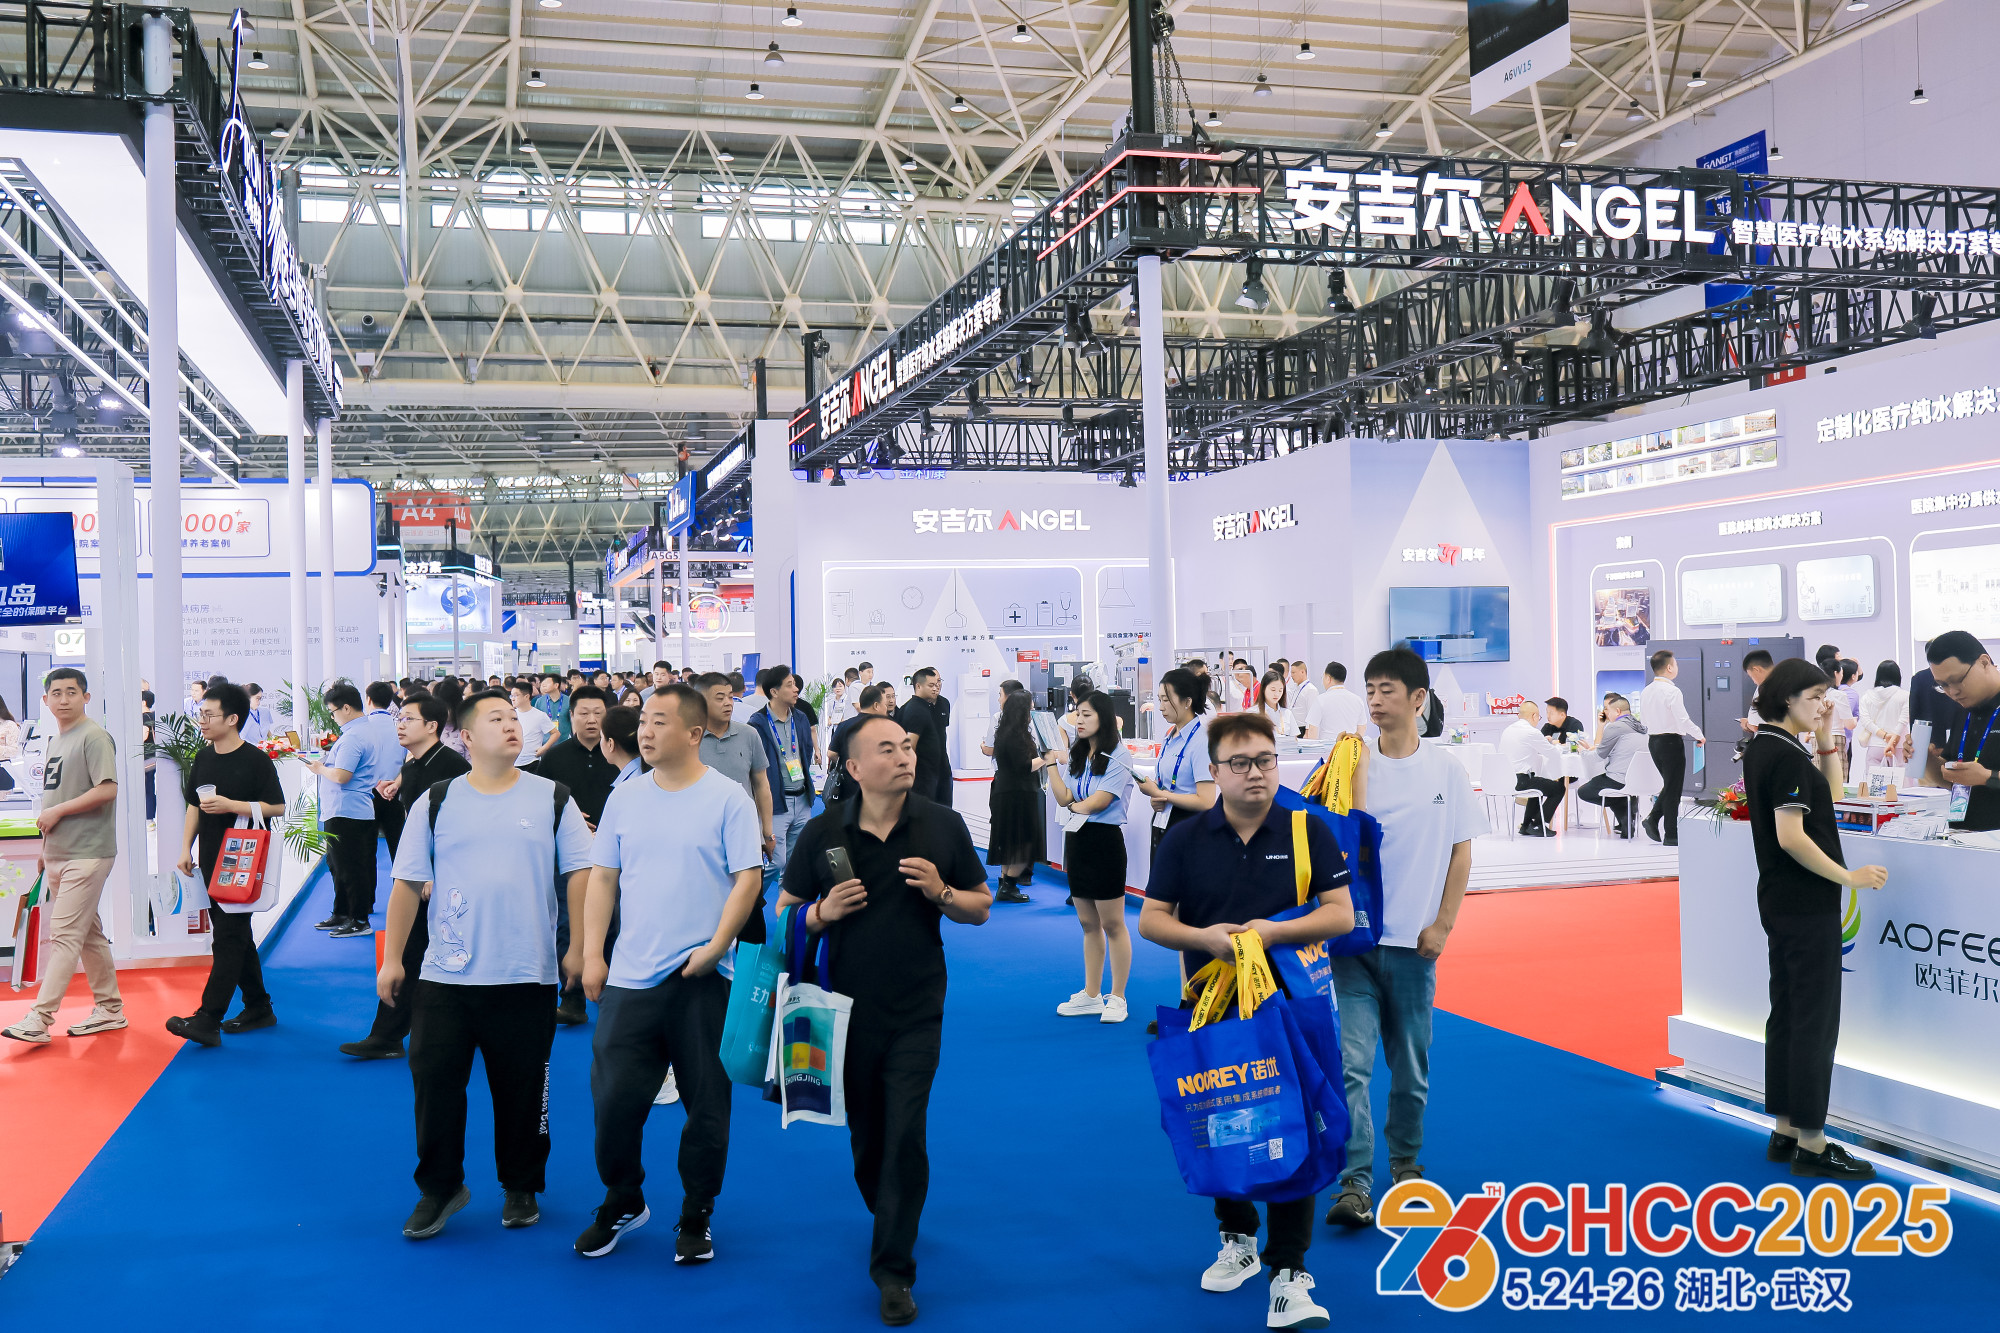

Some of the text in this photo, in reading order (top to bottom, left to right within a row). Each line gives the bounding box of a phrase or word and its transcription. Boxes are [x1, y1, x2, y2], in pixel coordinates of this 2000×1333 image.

[1504, 60, 1532, 83] A6VV15
[1285, 166, 1483, 236] 安吉尔
[1497, 181, 1715, 243] ANGEL
[852, 349, 895, 417] ANGEL
[819, 377, 852, 440] 安吉尔
[1816, 385, 2000, 444] 定制化医疗纯水解决
[401, 498, 436, 521] A4
[453, 500, 467, 524] A4
[912, 508, 993, 534] 安吉尔
[998, 509, 1091, 531] ANGEL
[1249, 503, 1297, 533] ANGEL
[1212, 511, 1249, 541] 安吉尔
[1915, 963, 2000, 1003] 欧菲尔
[1250, 1056, 1280, 1081] 诺优
